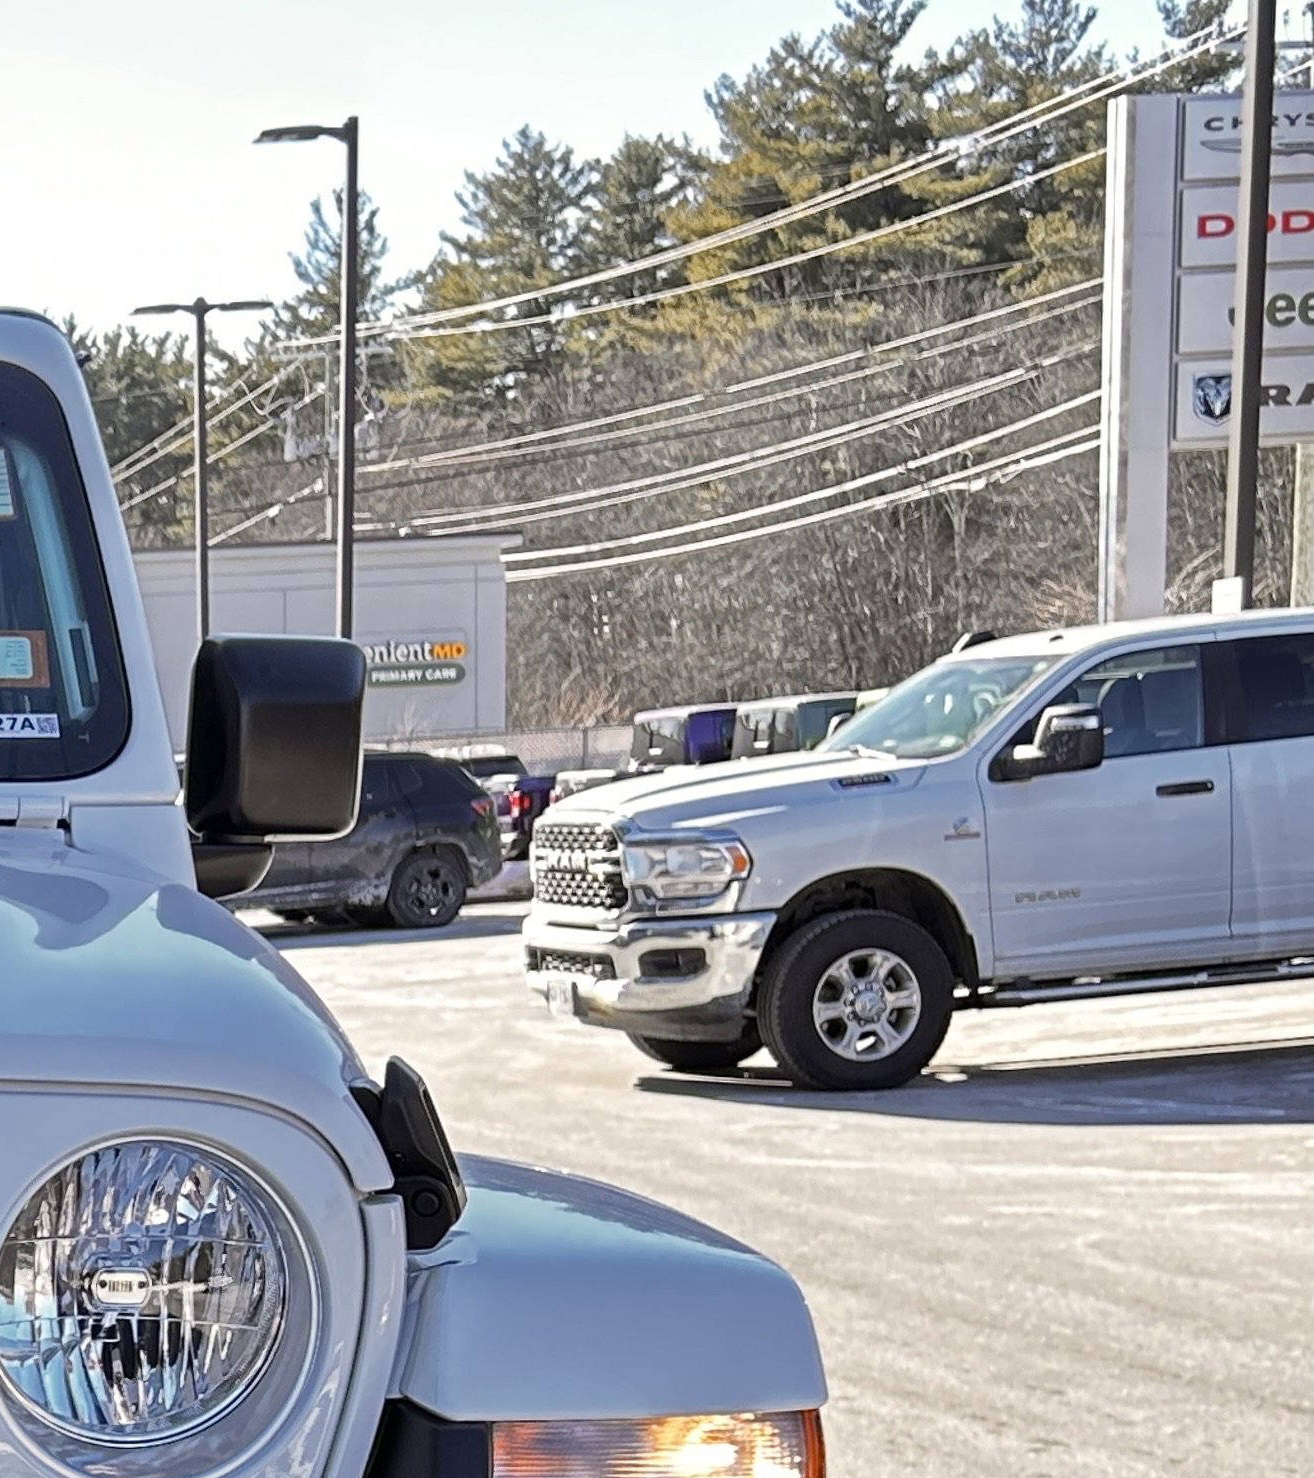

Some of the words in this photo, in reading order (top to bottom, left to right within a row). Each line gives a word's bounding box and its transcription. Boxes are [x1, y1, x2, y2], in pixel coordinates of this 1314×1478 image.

[1197, 210, 1314, 239] DD
[1228, 291, 1314, 328] ee
[371, 669, 423, 683] PRIMARY
